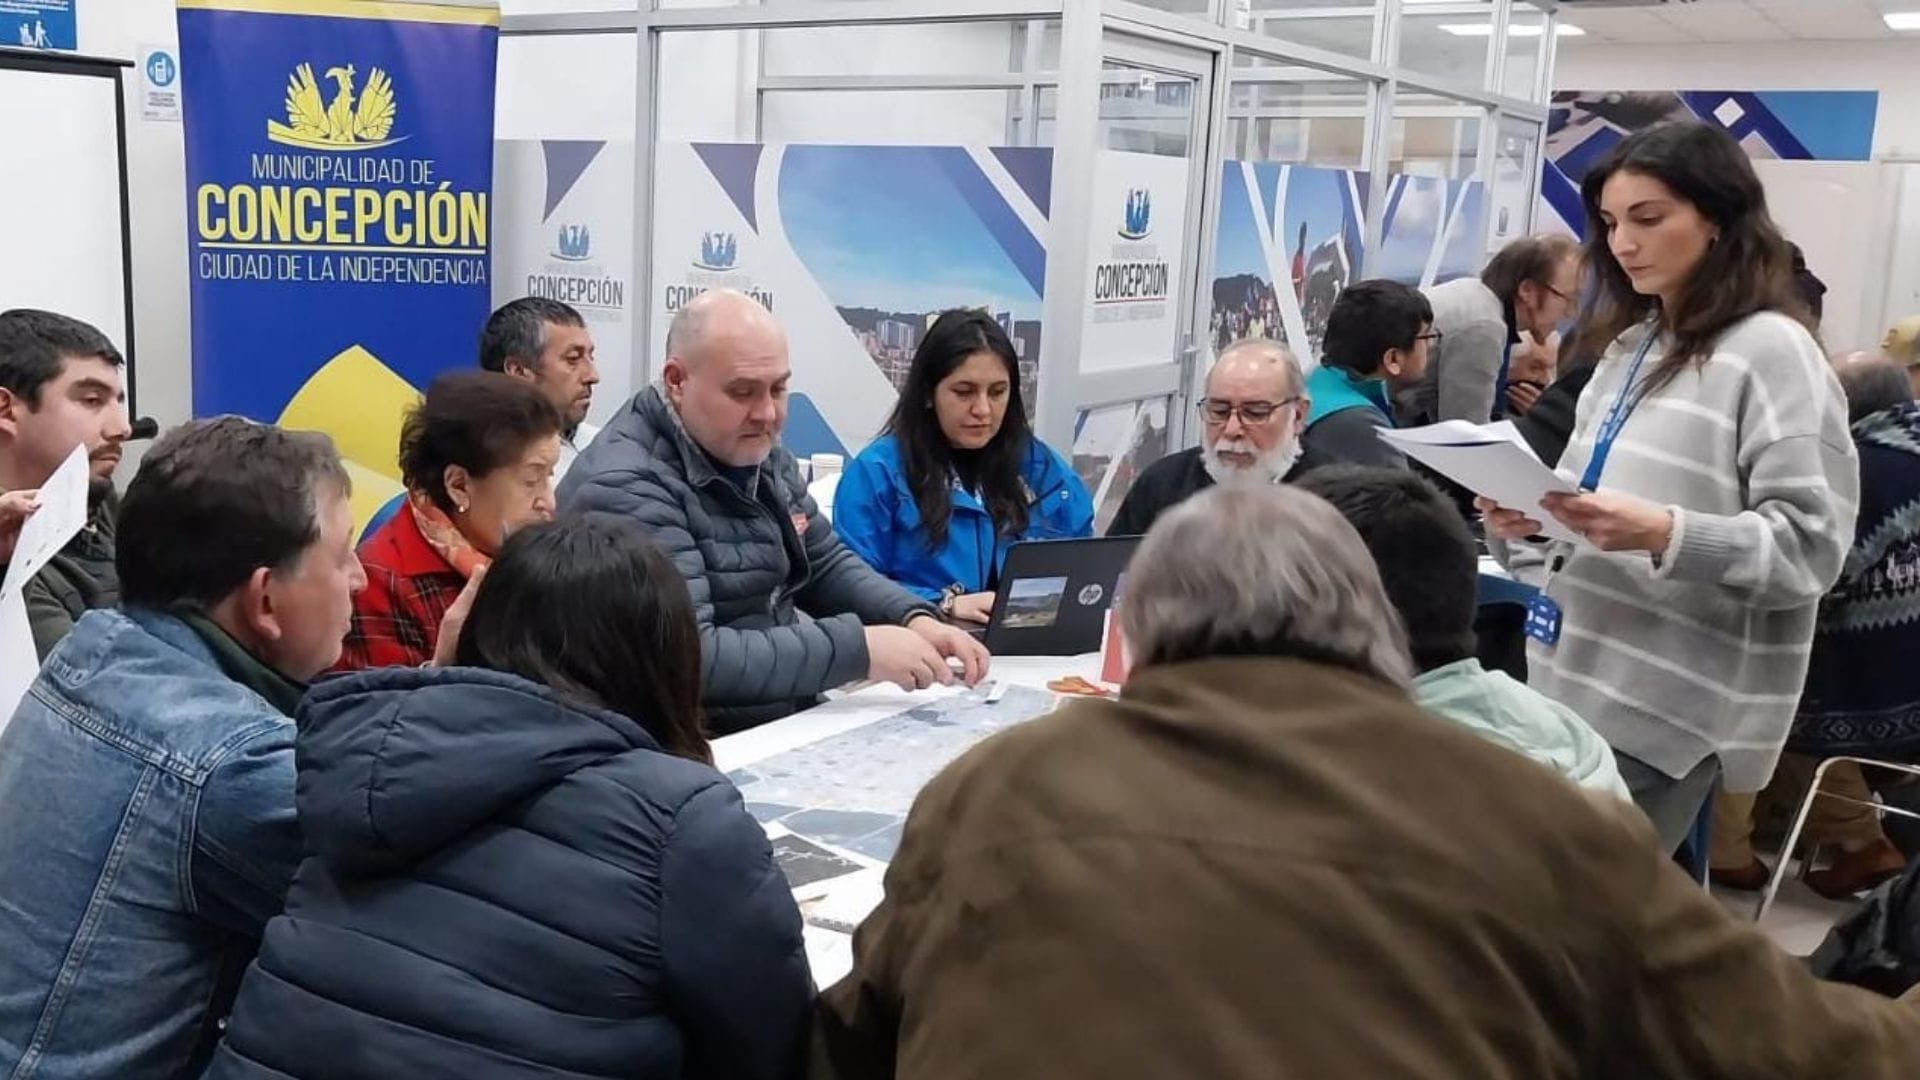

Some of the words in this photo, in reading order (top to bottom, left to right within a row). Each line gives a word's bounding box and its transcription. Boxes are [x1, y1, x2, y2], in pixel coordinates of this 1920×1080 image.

[252, 154, 404, 183] MUNICIPALIDAD
[411, 159, 435, 184] DE
[198, 181, 486, 246] CONCEPCIÓN
[200, 252, 271, 280] CIUDAD
[277, 254, 302, 281] DE
[309, 256, 332, 281] LA
[341, 257, 486, 285] INDEPENDENCIA
[1095, 257, 1169, 299] CONCEPCIÓN
[527, 275, 623, 305] CONCEPCIÓN
